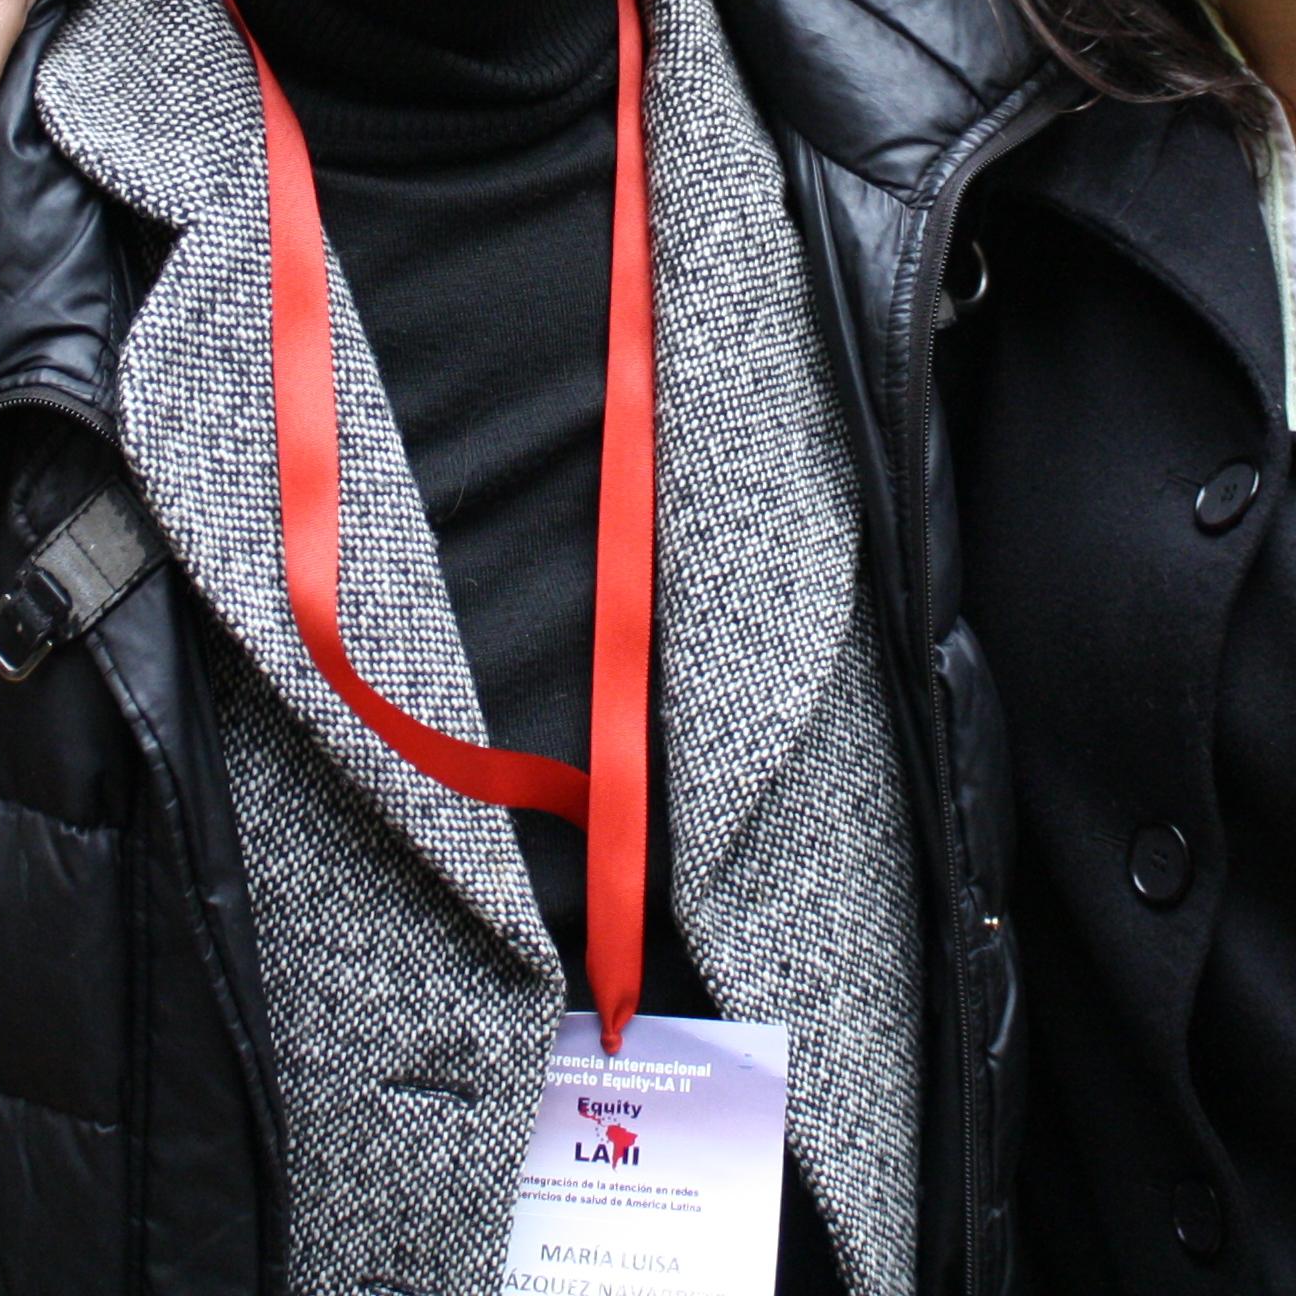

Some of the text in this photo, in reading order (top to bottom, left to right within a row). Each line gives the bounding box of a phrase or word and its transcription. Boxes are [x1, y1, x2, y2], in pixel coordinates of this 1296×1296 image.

[608, 1057, 712, 1077] Internacional
[602, 1073, 675, 1093] Equity-LA
[679, 1077, 691, 1093] II
[577, 1097, 642, 1119] Equity
[575, 1142, 611, 1164] LA
[581, 1179, 594, 1189] de
[597, 1180, 606, 1190] la
[608, 1182, 652, 1194] atención
[655, 1187, 668, 1195] en
[671, 1186, 700, 1197] redes
[565, 1193, 577, 1203] de
[580, 1195, 608, 1206] salud
[610, 1197, 622, 1207] de
[625, 1198, 667, 1210] América
[670, 1201, 702, 1213] Latina
[540, 1244, 681, 1274] MARÍA LUISA
